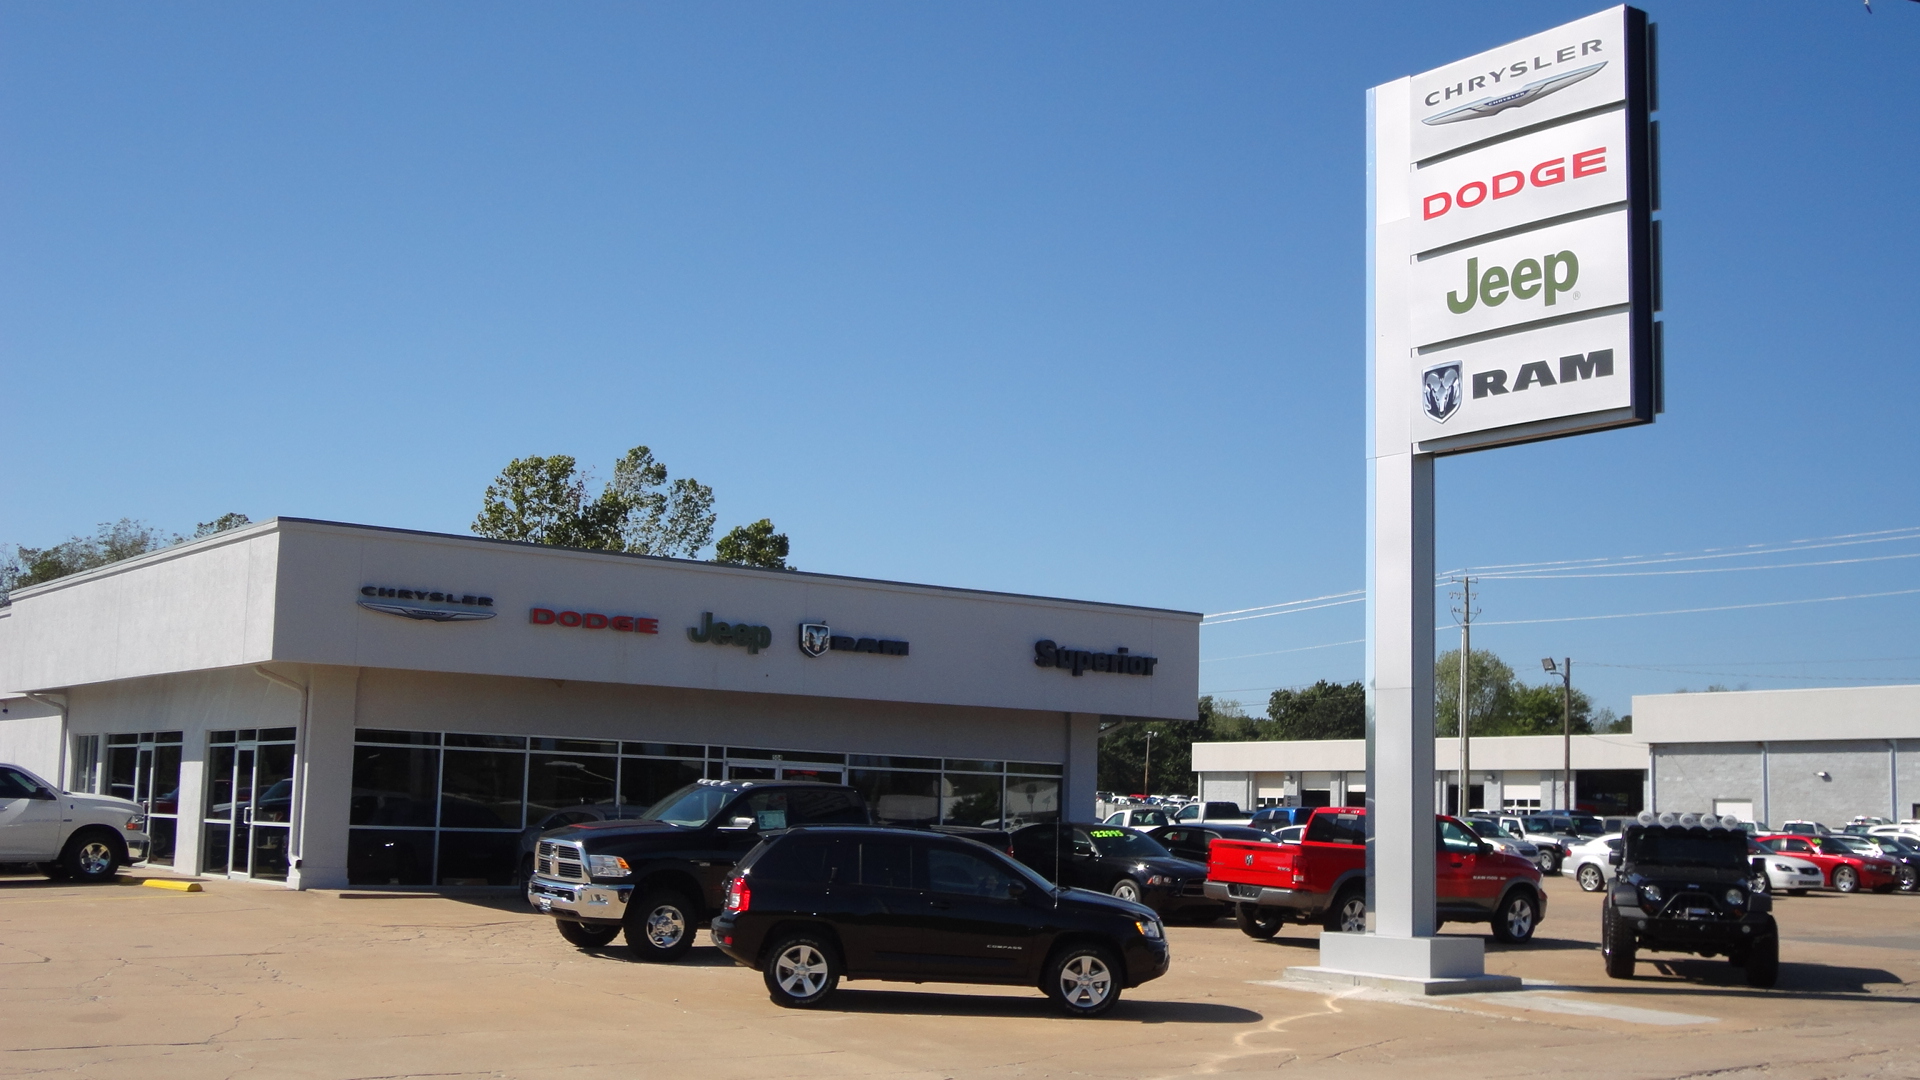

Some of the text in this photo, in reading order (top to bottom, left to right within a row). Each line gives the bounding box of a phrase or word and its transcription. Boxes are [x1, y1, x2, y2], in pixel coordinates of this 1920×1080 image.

[1424, 38, 1604, 107] CHRYSLER
[1488, 91, 1525, 106] CHRYSLER
[1423, 146, 1607, 221] DODGE
[1446, 249, 1580, 315] Jeep
[1472, 348, 1614, 399] RAM
[360, 585, 494, 607] CHRYSLER
[529, 607, 659, 635] DODGE
[687, 611, 772, 655] Jeep
[830, 634, 910, 656] RAM
[1034, 638, 1158, 677] Superior
